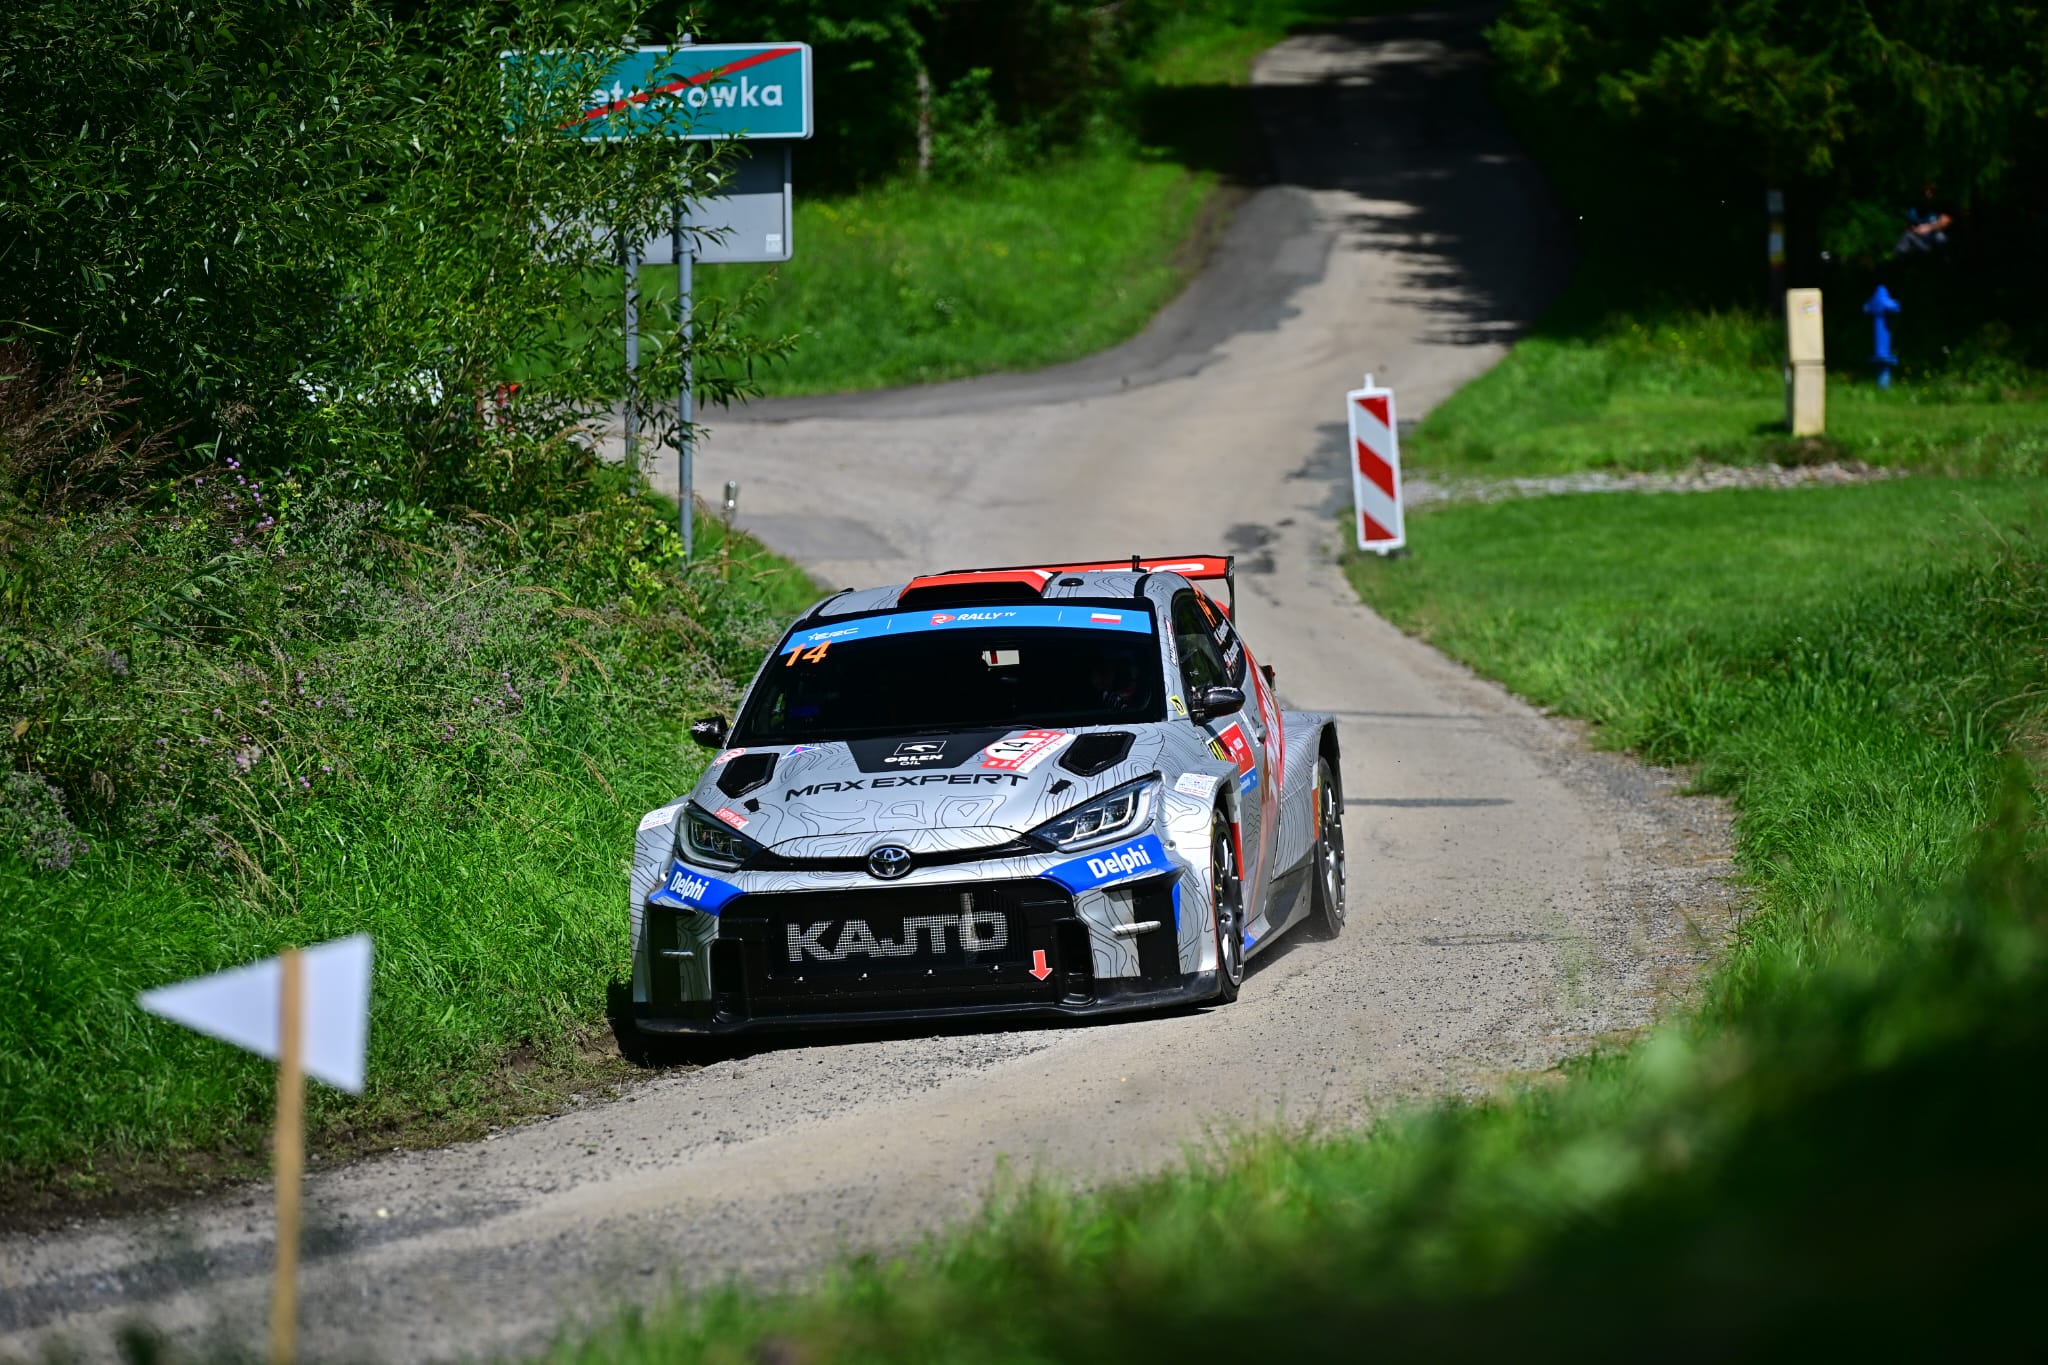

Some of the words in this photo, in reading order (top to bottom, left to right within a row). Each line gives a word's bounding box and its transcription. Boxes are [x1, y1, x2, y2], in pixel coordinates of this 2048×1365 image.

[785, 641, 832, 666] 14
[883, 754, 943, 763] ORLEN
[993, 741, 1034, 753] 14
[785, 779, 865, 802] MAX
[870, 773, 1029, 789] EXPERT
[1086, 843, 1152, 880] Delphi
[669, 870, 708, 901] Delphi
[786, 910, 1010, 962] KAJTO
